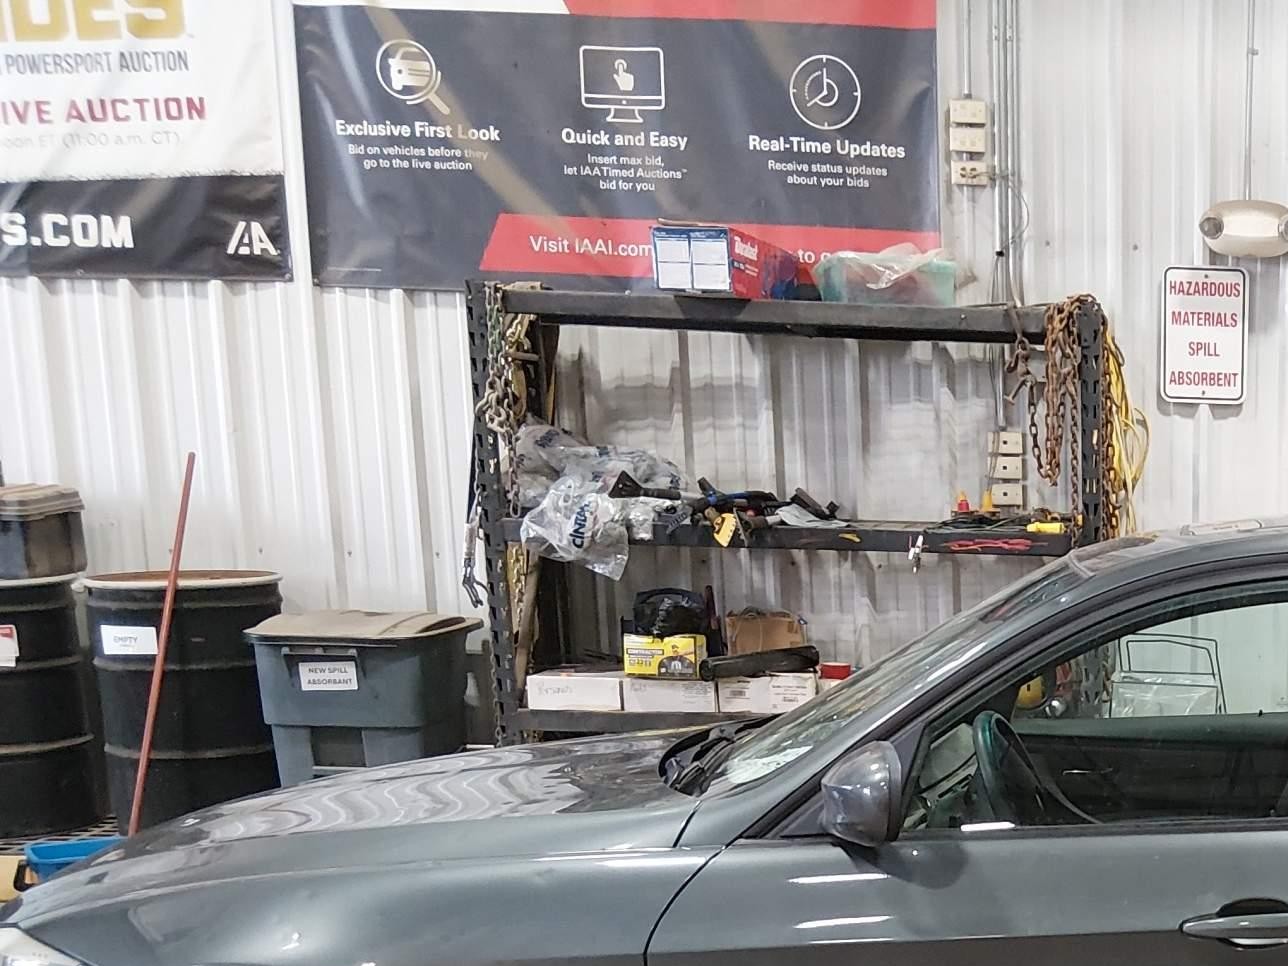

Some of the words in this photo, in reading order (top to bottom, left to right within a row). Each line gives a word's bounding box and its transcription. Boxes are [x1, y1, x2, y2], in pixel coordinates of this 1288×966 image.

[5, 52, 112, 75] POWERSPORT
[119, 50, 190, 73] AUCTION
[66, 97, 207, 123] AUCTION
[335, 120, 411, 137] Exclusive
[414, 121, 453, 138] First
[458, 124, 501, 141] Look
[561, 128, 610, 146] Quick
[614, 131, 645, 146] and
[650, 131, 688, 151] Easy
[749, 135, 832, 154] Real-Time
[836, 139, 906, 159] Updates
[349, 144, 365, 155] Bid
[367, 147, 380, 155] on
[383, 145, 425, 157] vehicles
[428, 147, 462, 158] before
[464, 149, 489, 161] they
[588, 153, 618, 165] Insert
[620, 156, 642, 165] max
[645, 155, 665, 167] bid,
[364, 160, 377, 170] go
[380, 160, 390, 168] to
[392, 159, 409, 168] the
[412, 159, 431, 169] live
[434, 160, 473, 171] auction
[564, 165, 578, 176] let
[581, 166, 600, 176] IAA
[601, 166, 635, 178] Timed
[768, 160, 809, 173] Receive
[811, 162, 843, 174] status
[845, 164, 888, 177] updates
[600, 179, 617, 190] bid
[618, 179, 633, 190] for
[635, 182, 655, 192] you
[787, 174, 818, 185] about
[820, 176, 844, 188] your
[847, 176, 870, 188] bids
[1, 211, 135, 248] S.COM
[529, 235, 570, 253] Visit
[575, 237, 653, 256] IAAI.com
[797, 248, 816, 264] to
[1169, 280, 1241, 298] HAZARDOUS
[1171, 311, 1238, 328] MATERIALS
[1188, 341, 1220, 357] SPILL
[1169, 370, 1239, 388] ABSORBENT
[328, 666, 349, 674] SPILL
